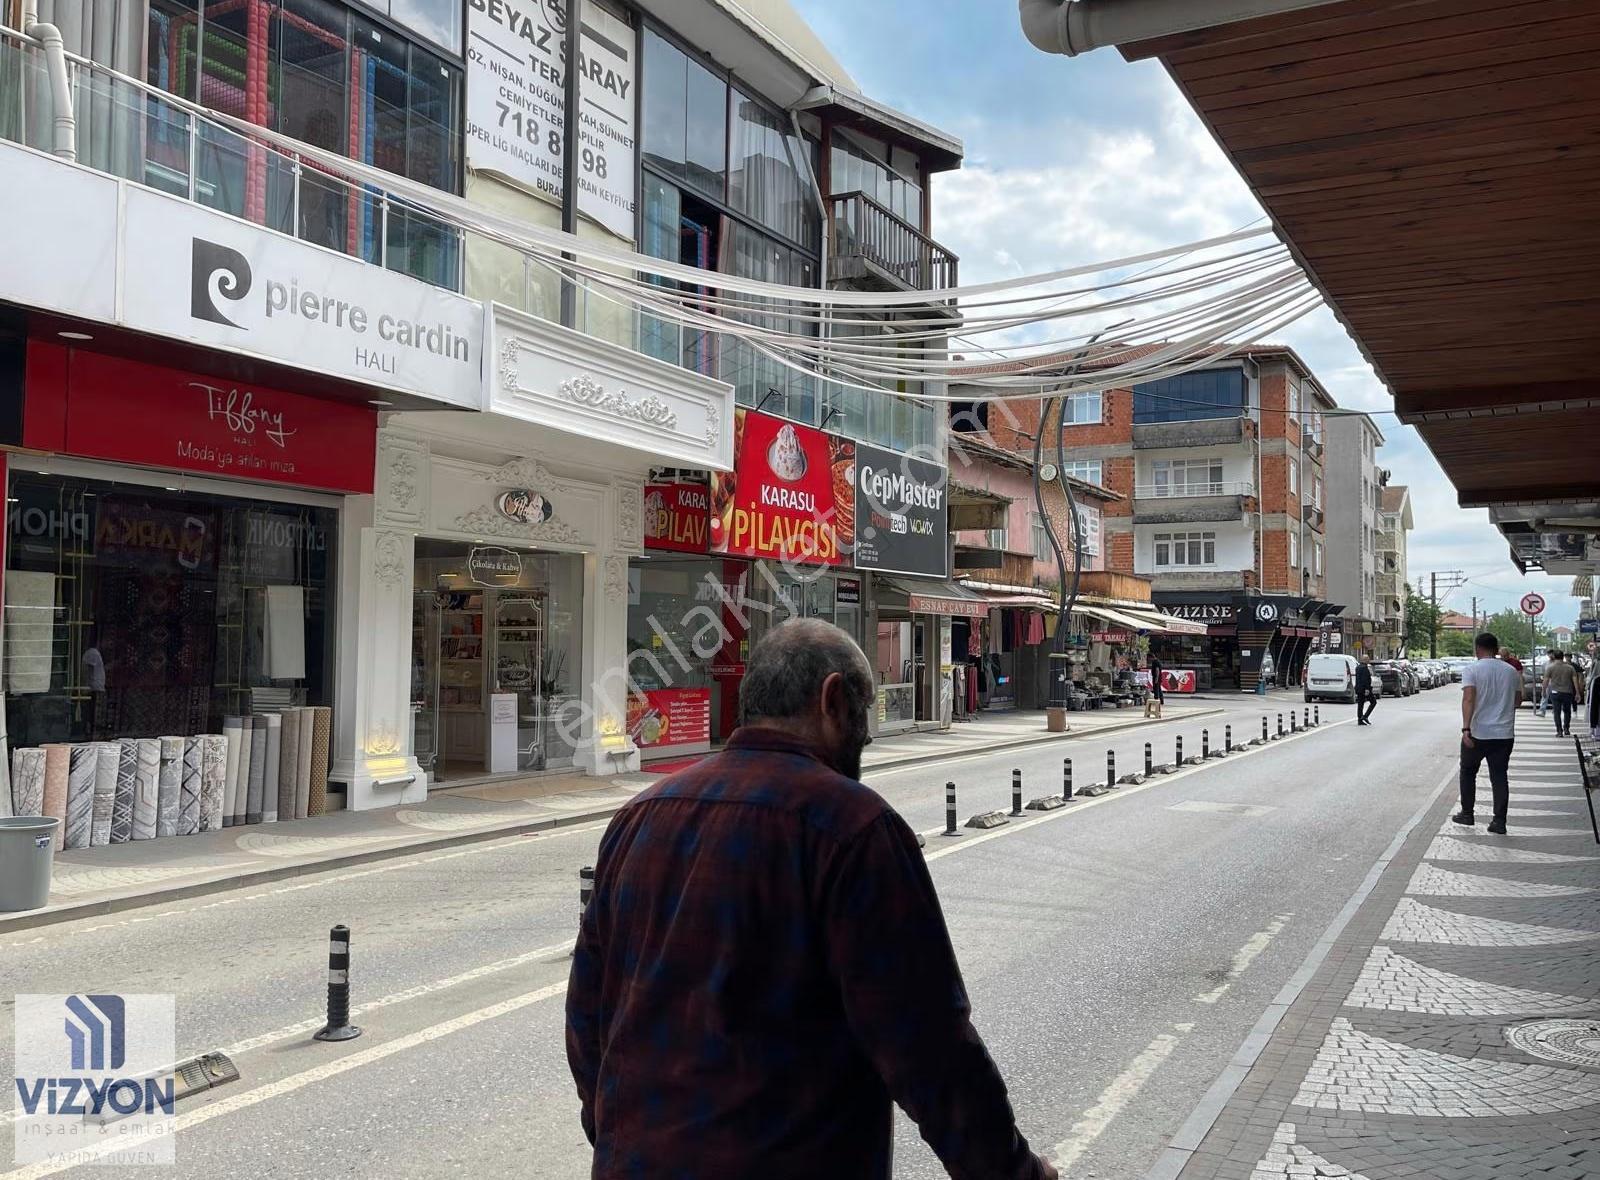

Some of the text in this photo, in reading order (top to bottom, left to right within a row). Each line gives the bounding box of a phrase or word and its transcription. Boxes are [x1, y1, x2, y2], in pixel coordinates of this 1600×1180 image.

[496, 100, 540, 146] 718
[582, 148, 607, 179] 98
[266, 277, 469, 362] pierre cardin
[355, 346, 396, 375] HALI
[188, 382, 297, 447] Tiffany
[177, 440, 233, 468] Moda'ya
[678, 490, 708, 510] KARA
[761, 484, 815, 512] KARASU
[860, 465, 943, 510] CepMaster
[656, 504, 708, 545] PİLAV
[735, 501, 837, 559] PİLAVCISI
[1161, 605, 1232, 618] AZİZİYE
